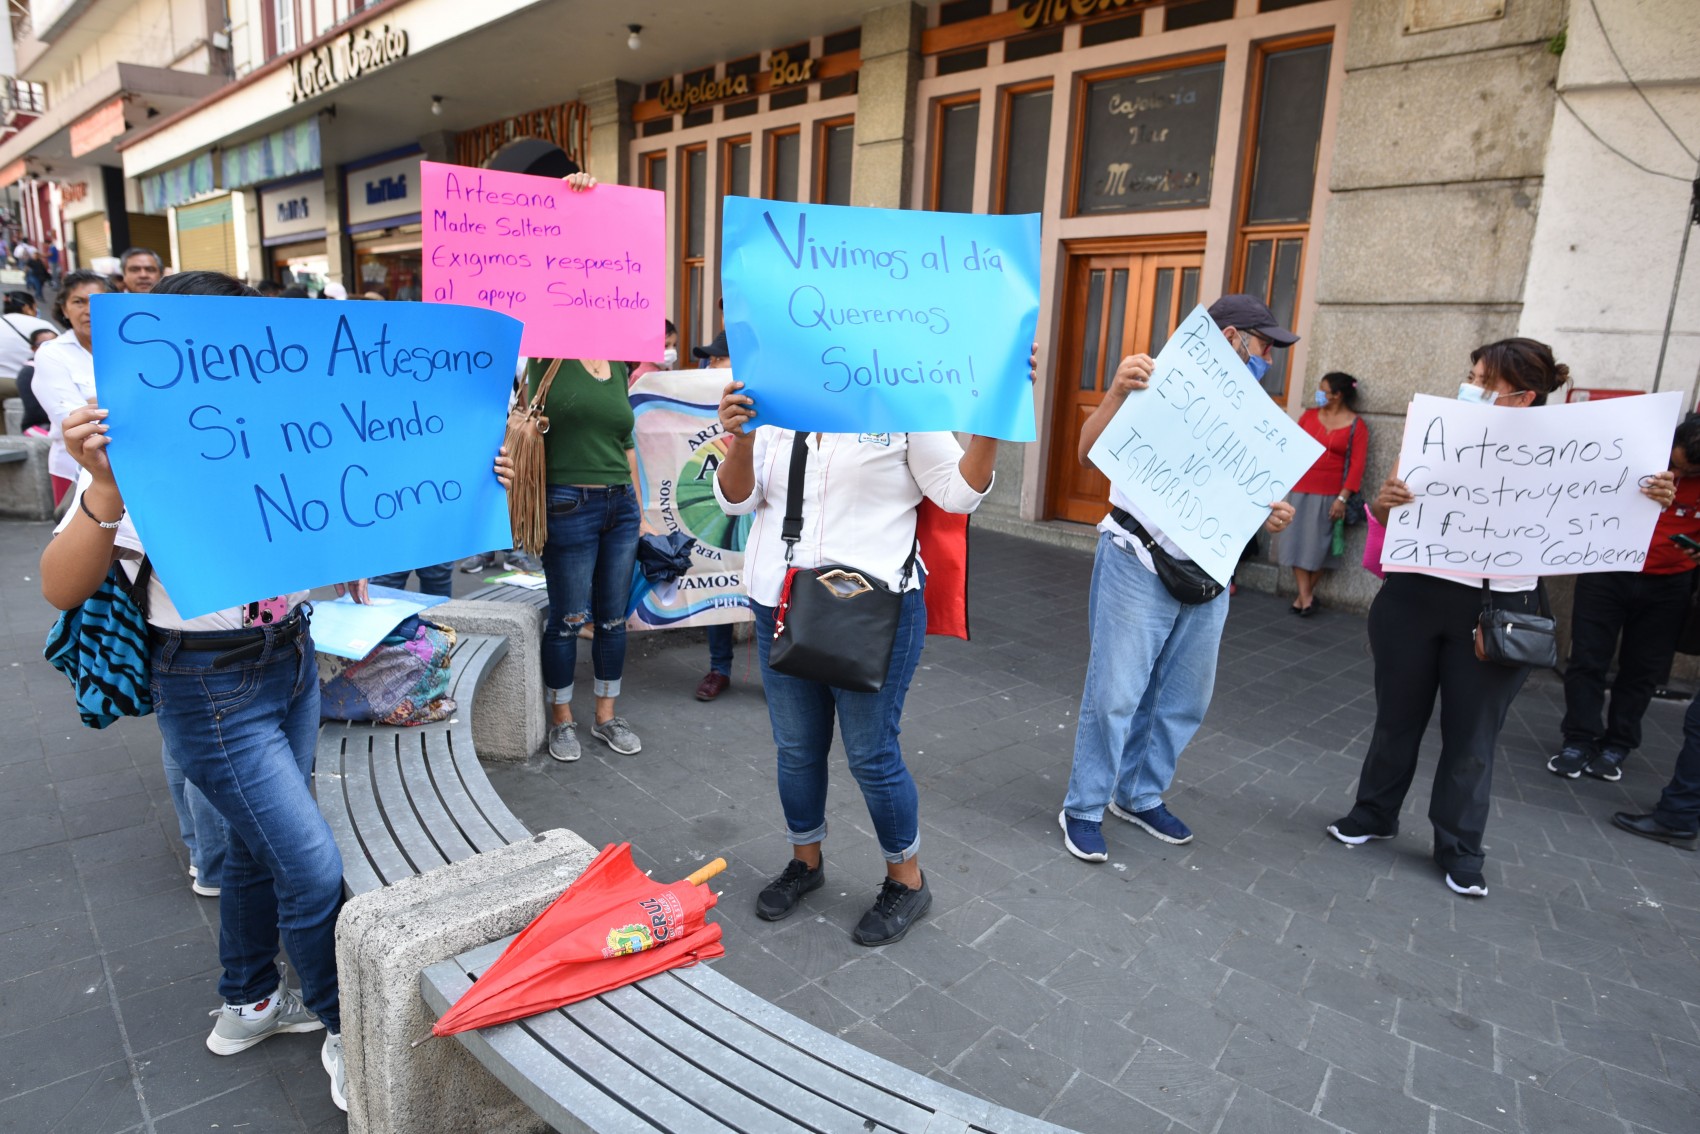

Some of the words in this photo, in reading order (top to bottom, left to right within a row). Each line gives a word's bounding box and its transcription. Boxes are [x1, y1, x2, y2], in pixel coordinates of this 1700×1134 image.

[768, 51, 814, 87] Bar
[446, 172, 557, 210] Artesana
[434, 209, 487, 235] Madre
[495, 217, 562, 237] Soltera
[763, 211, 909, 280] Vivimos
[921, 235, 950, 274] al
[963, 240, 1004, 273] día
[432, 244, 532, 278] Exigimos
[545, 251, 642, 278] respuesta
[434, 279, 454, 302] al
[478, 289, 527, 308] apoyo
[546, 281, 650, 310] Solicitado
[788, 285, 950, 335] Queremos
[118, 311, 309, 390] Siendo
[326, 314, 493, 383] Artesano
[822, 346, 979, 398] Solución!
[1183, 315, 1245, 410] PEDIMOS
[1254, 419, 1288, 453] SER
[188, 404, 251, 461] Si
[280, 420, 333, 454] no
[340, 399, 445, 443] Vendo
[687, 422, 726, 453] ART
[1156, 367, 1286, 508] ESCUCHADOS
[1422, 416, 1624, 469] Artesanos
[1108, 426, 1233, 559] IGNORADOS
[1180, 453, 1212, 487] NO
[253, 472, 330, 543] No
[340, 464, 462, 528] Como
[1398, 502, 1424, 530] el
[1440, 511, 1551, 545] futuro,
[1568, 513, 1620, 536] sin
[1389, 538, 1523, 571] apoyo
[1540, 540, 1646, 567] Gobierno
